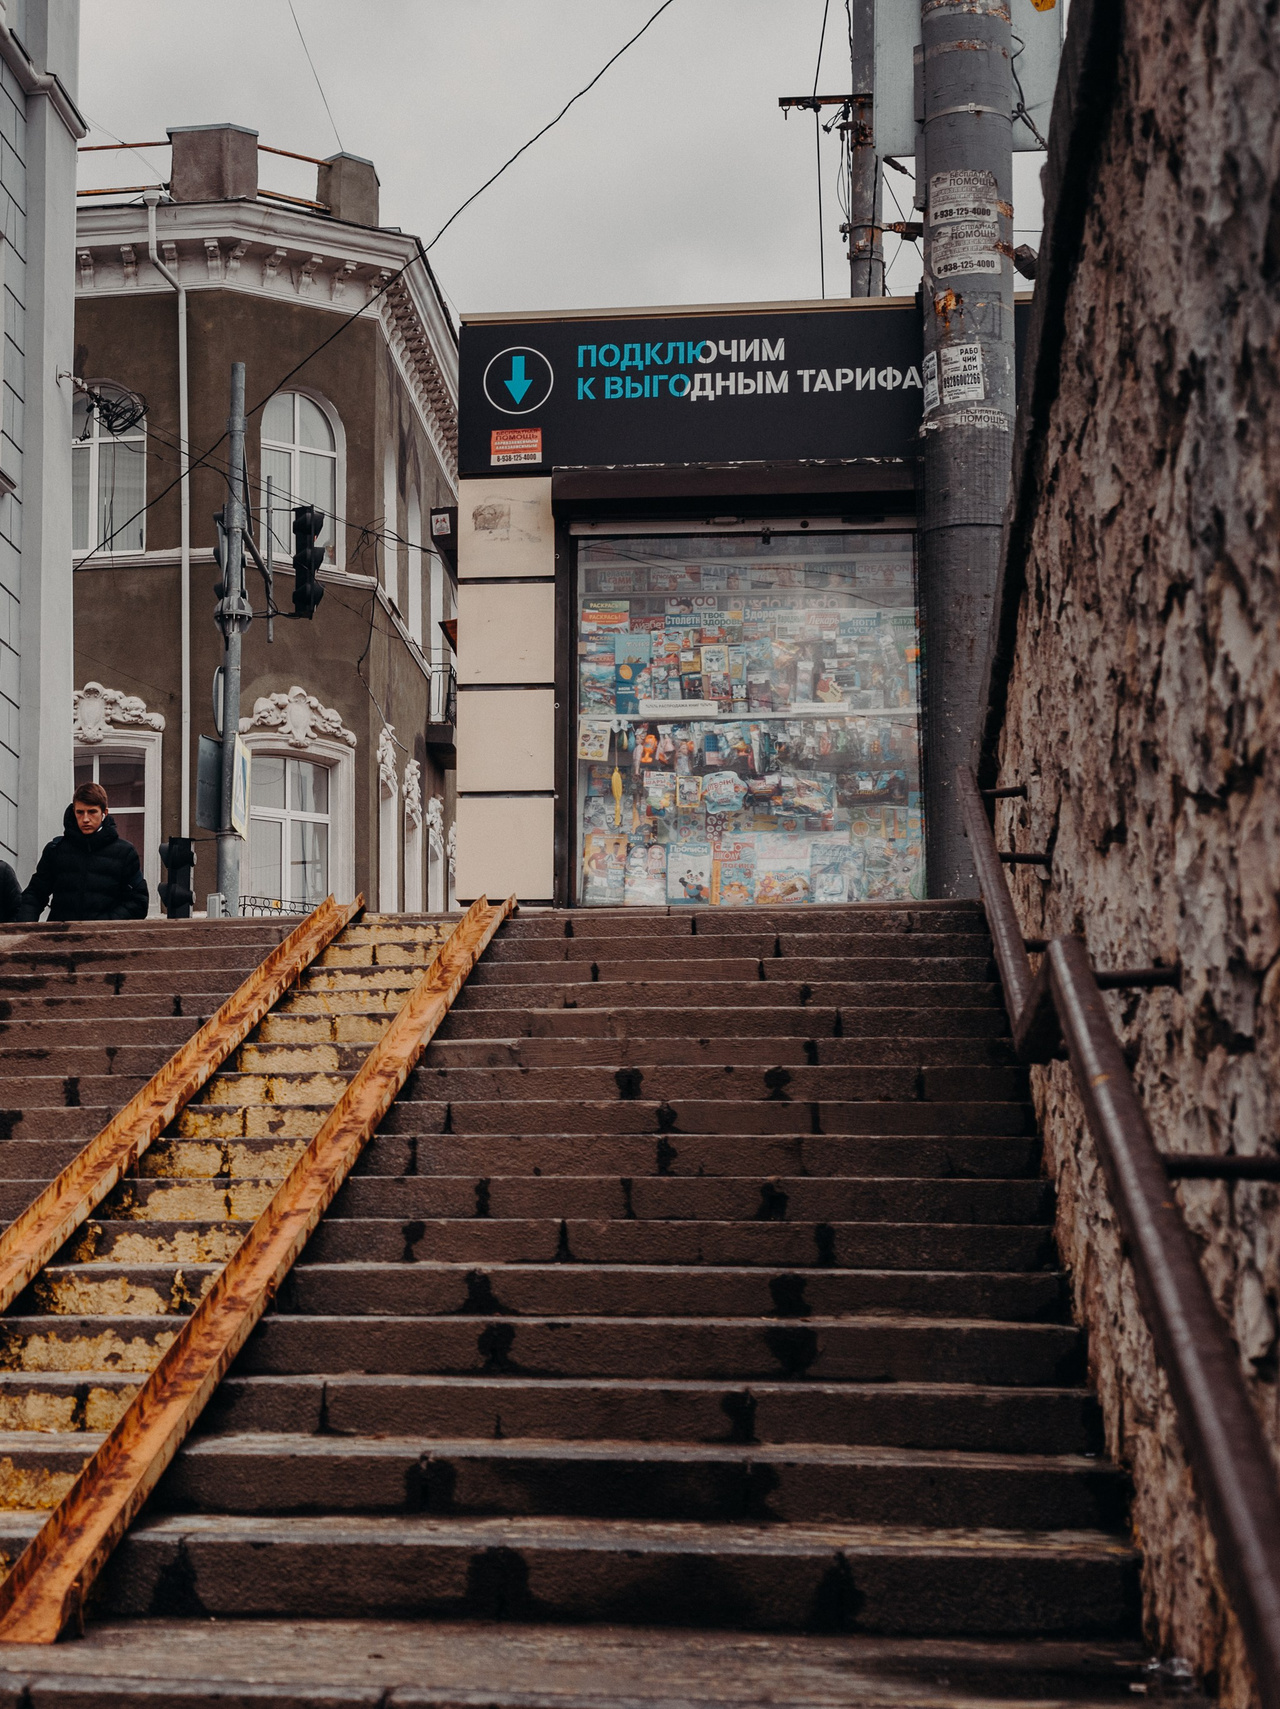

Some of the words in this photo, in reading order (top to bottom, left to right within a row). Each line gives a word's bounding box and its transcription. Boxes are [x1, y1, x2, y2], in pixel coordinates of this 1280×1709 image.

[949, 178, 995, 187] ПОМОЩЬ
[934, 207, 991, 220] 8-938-125-4000
[951, 230, 997, 240] ПОМОЩЬ
[937, 260, 995, 274] 8-938-125-4000
[577, 337, 786, 372] ПОДКЛЮЧИМ
[959, 347, 978, 355] РАБО
[962, 354, 977, 363] ЧИЙ
[962, 364, 978, 372] ДОМ
[577, 377, 596, 400] К
[604, 370, 789, 401] ВЫГОДНЫМ
[797, 366, 924, 393] ТАРИФА
[960, 415, 1005, 425] ПОМОЩЬ
[496, 433, 538, 441] ПОМОЩЬ
[496, 453, 537, 463] 8-938-125-4000
[852, 619, 877, 627] НОГИ
[670, 844, 708, 853] Прописи
